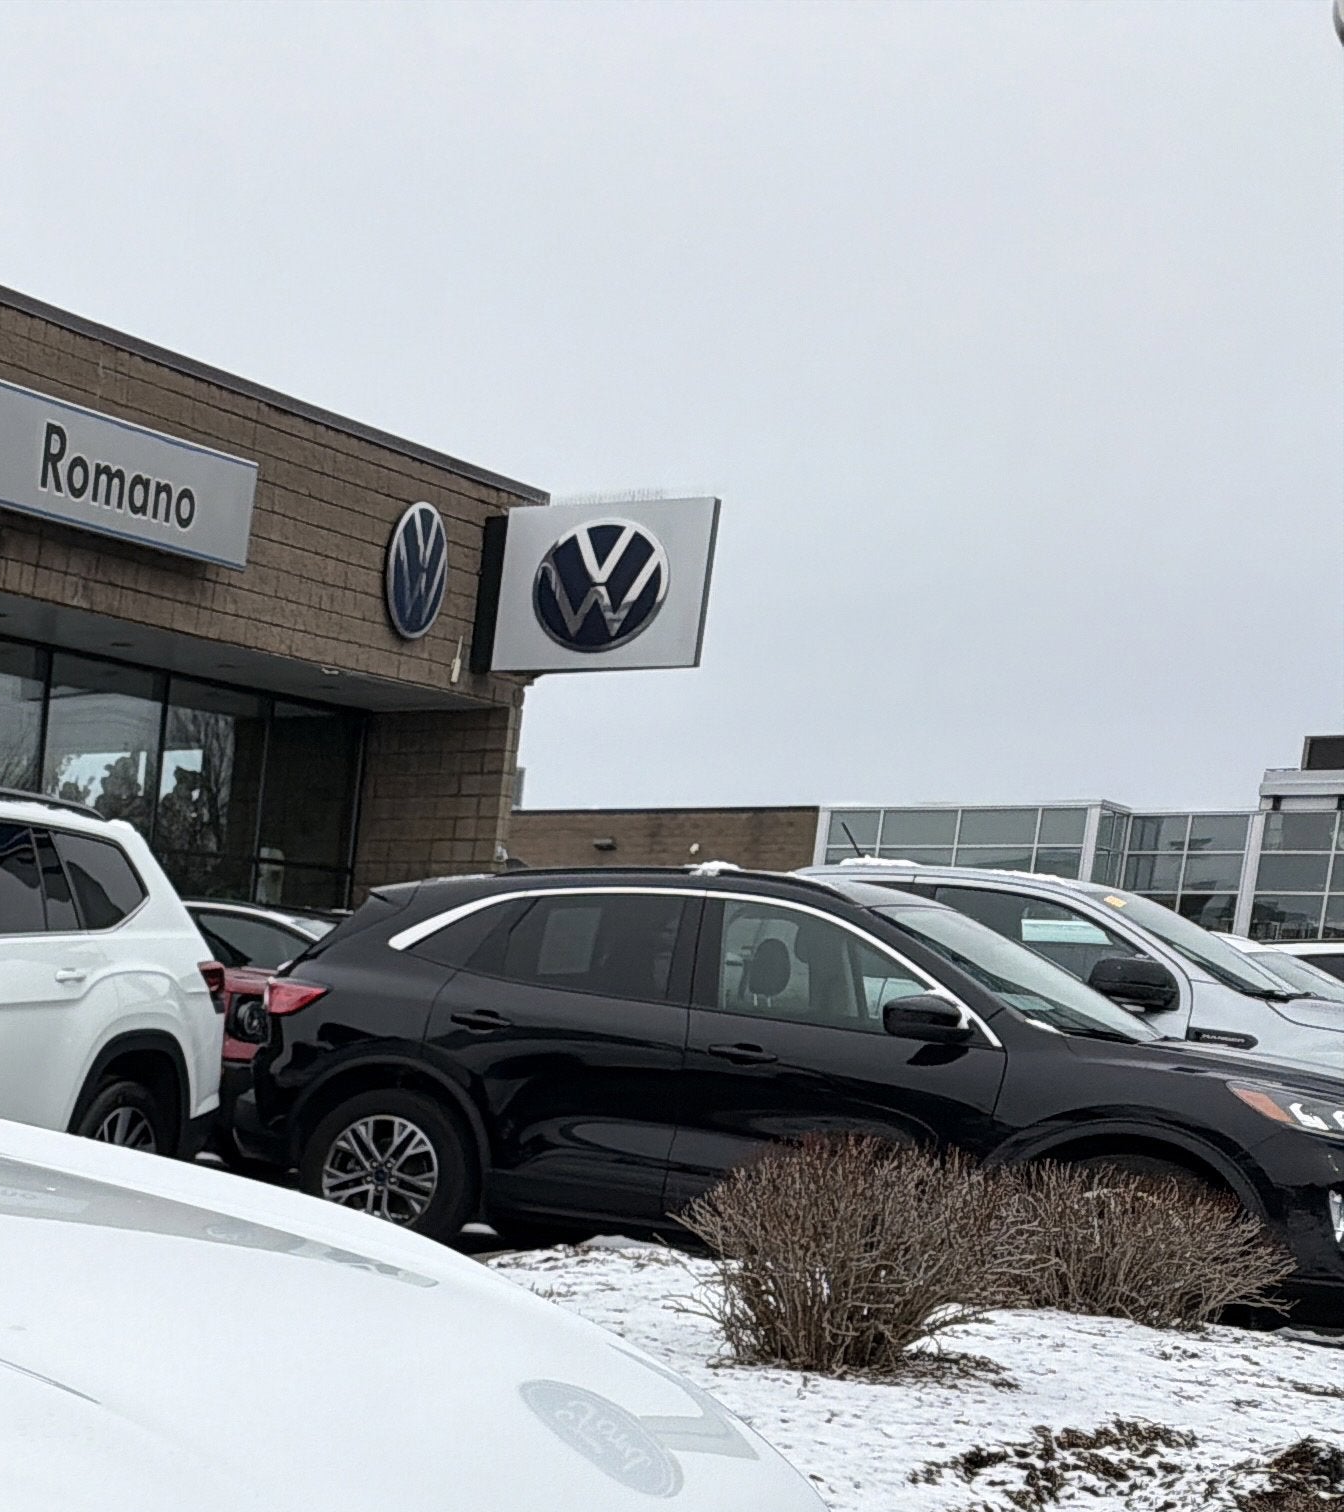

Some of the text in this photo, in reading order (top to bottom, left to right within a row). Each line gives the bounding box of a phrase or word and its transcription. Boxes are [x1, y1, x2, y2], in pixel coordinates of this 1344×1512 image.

[40, 421, 195, 529] Romano
[390, 504, 448, 636] VW
[534, 519, 668, 650] VW
